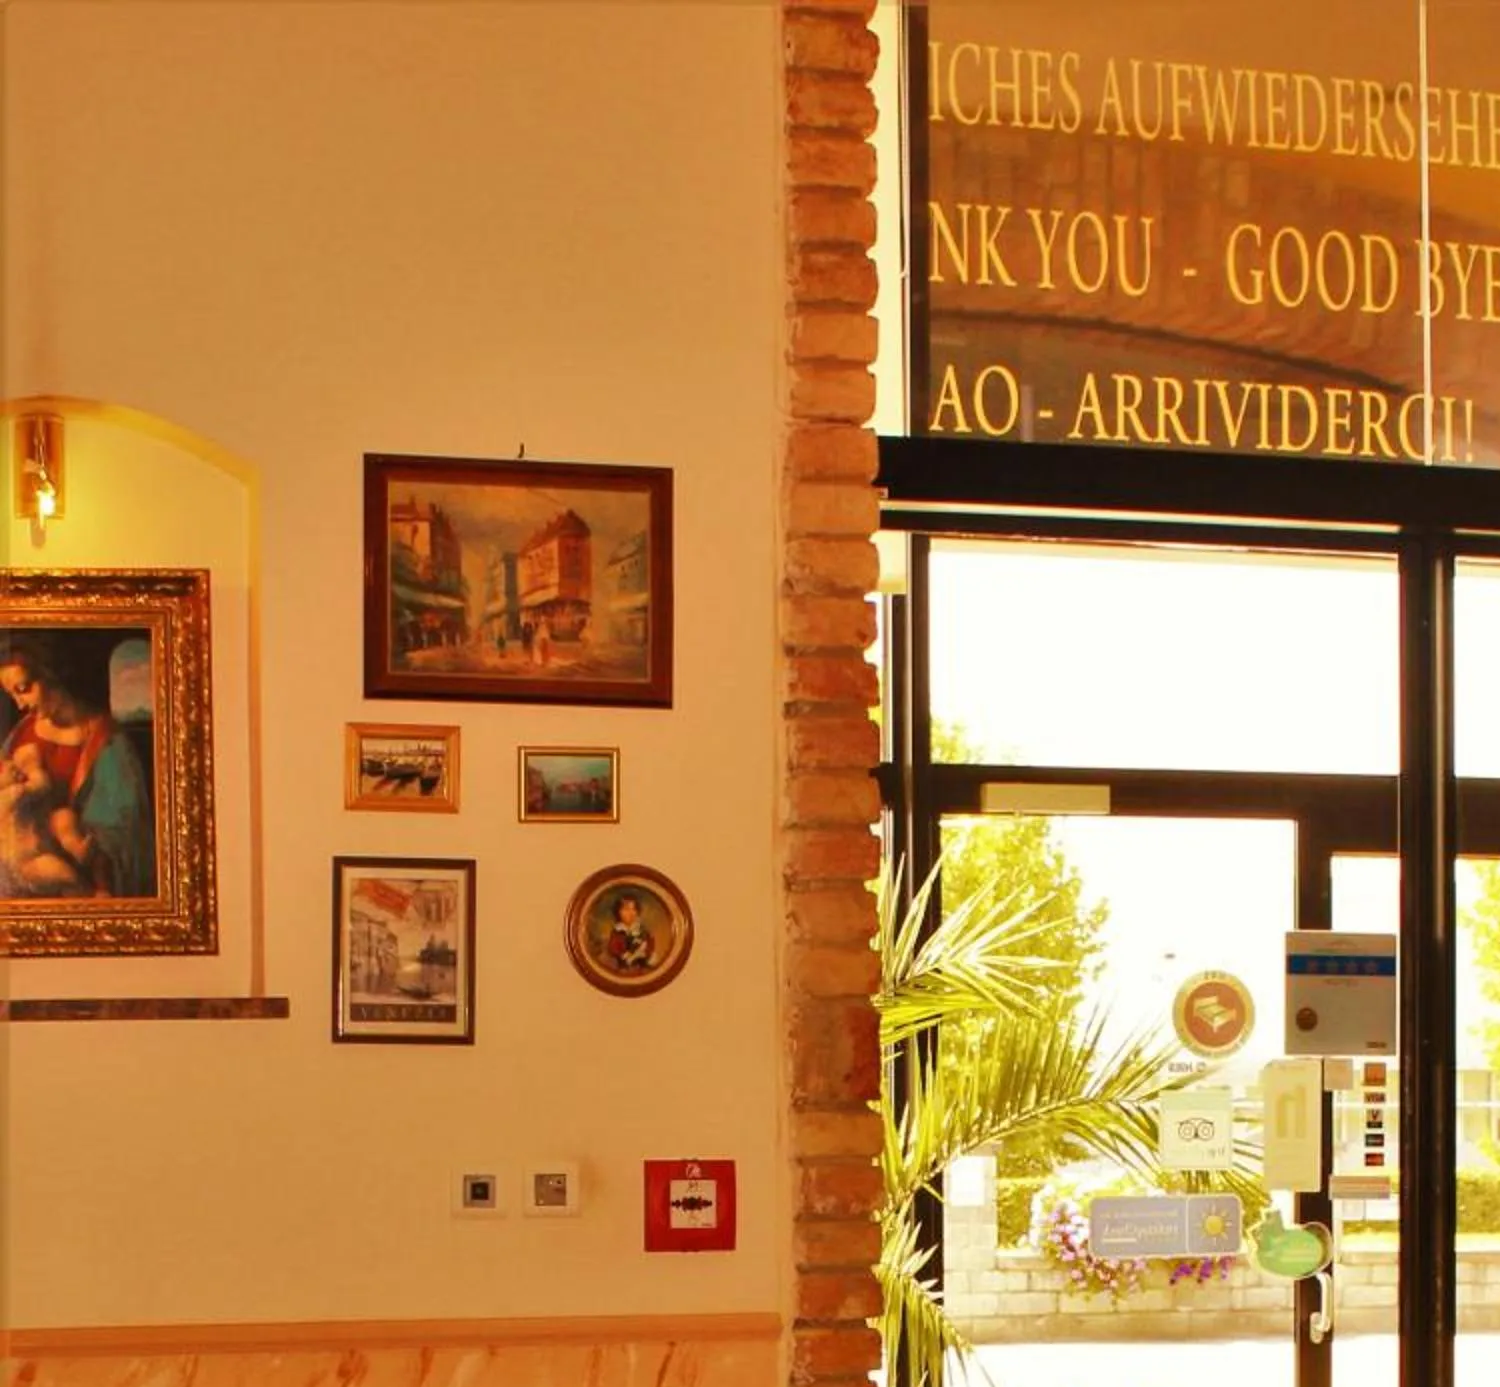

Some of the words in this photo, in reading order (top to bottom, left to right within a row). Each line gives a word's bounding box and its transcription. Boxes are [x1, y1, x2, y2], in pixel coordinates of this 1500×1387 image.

[928, 41, 1082, 134] ICHES
[928, 201, 1018, 286] NK
[1025, 208, 1155, 297] YOU
[1182, 267, 1198, 277] -
[1226, 223, 1400, 314] GOOD
[929, 364, 1018, 436] AO
[1037, 409, 1053, 419] -
[1067, 372, 1475, 464] ARRIVIDERCI!
